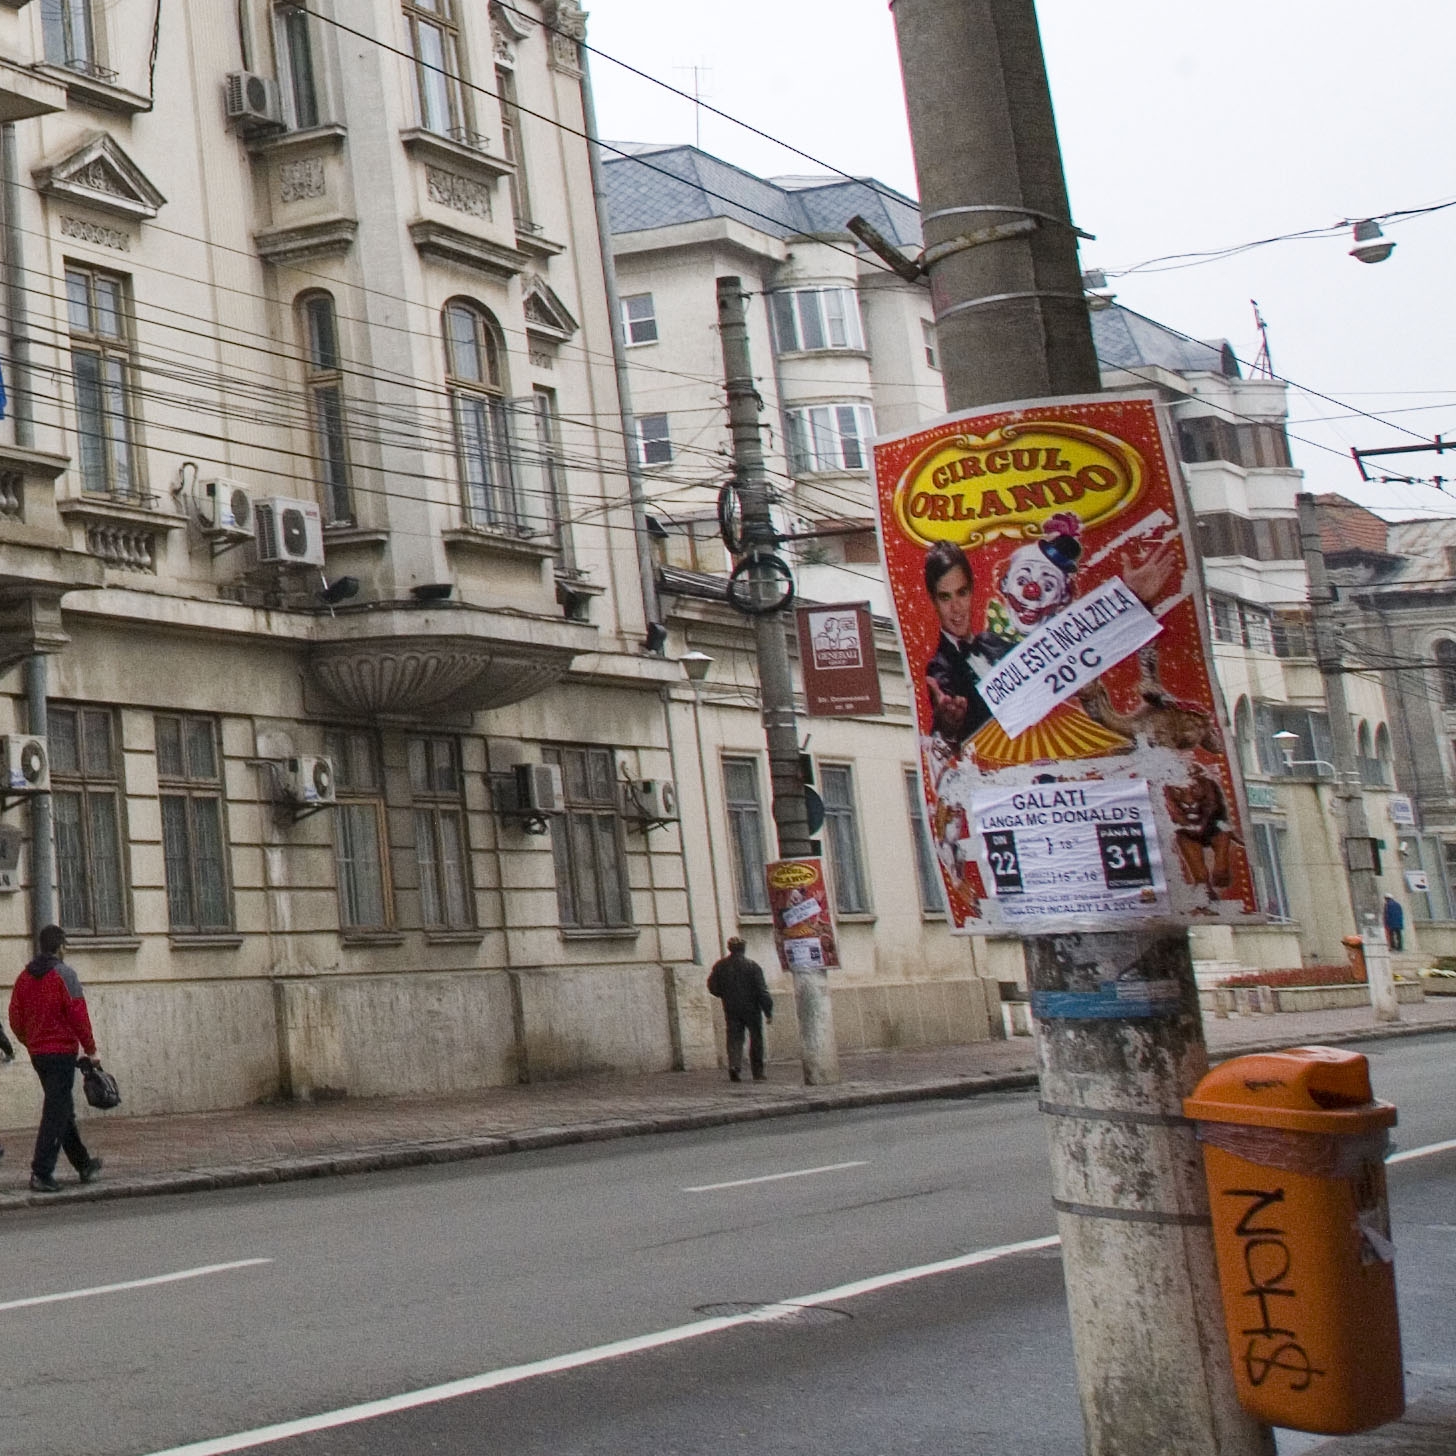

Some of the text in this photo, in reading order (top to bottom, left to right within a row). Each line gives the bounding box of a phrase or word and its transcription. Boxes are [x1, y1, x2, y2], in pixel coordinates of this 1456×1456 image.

[932, 448, 1071, 489] CIRCUL
[910, 464, 1118, 522] ORLANDO
[985, 662, 1030, 705] CIRCUL
[1019, 637, 1060, 674] ESTE
[1104, 588, 1135, 614] LA
[1012, 789, 1086, 811] GALATI
[982, 807, 1140, 830] LANGA MC DONALD'S
[989, 851, 1018, 876] 22
[1105, 843, 1142, 869] 31
